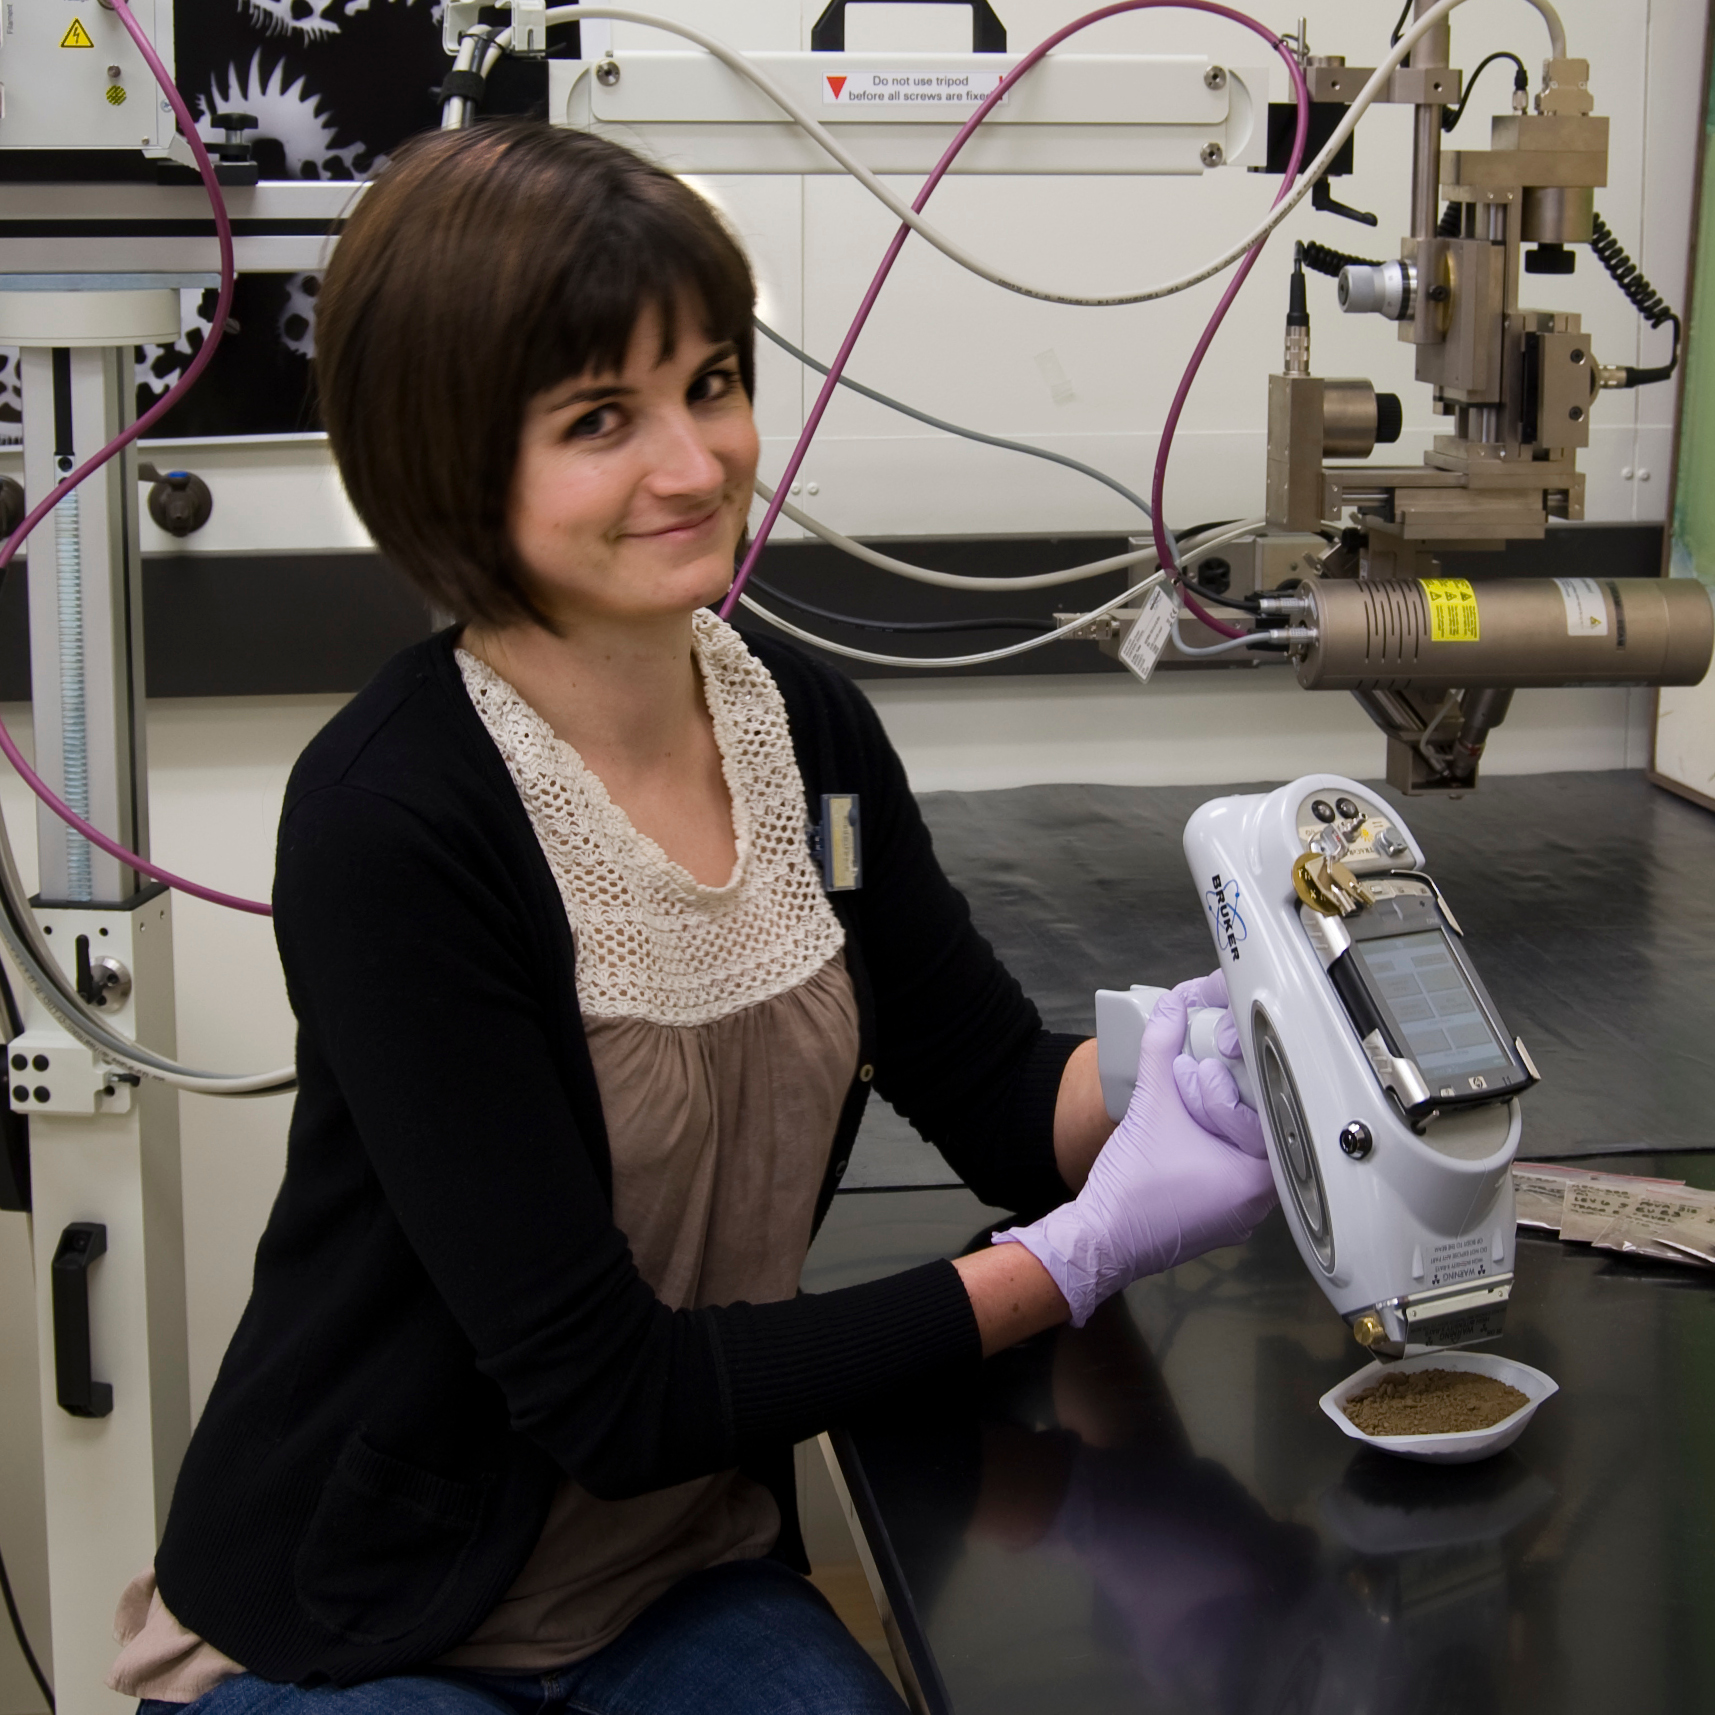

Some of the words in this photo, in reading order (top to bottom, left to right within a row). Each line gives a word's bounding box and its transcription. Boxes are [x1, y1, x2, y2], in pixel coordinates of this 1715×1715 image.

[872, 75, 888, 86] Do
[891, 76, 910, 86] not
[913, 78, 933, 86] use
[936, 75, 969, 88] tripod
[849, 91, 885, 101] before
[888, 91, 901, 101] all
[903, 93, 942, 101] screws
[945, 93, 963, 101] are
[1212, 874, 1240, 962] BRUKER
[1469, 1248, 1479, 1256] NOT
[1479, 1246, 1488, 1254] DO
[1442, 1268, 1476, 1281] WARNING
